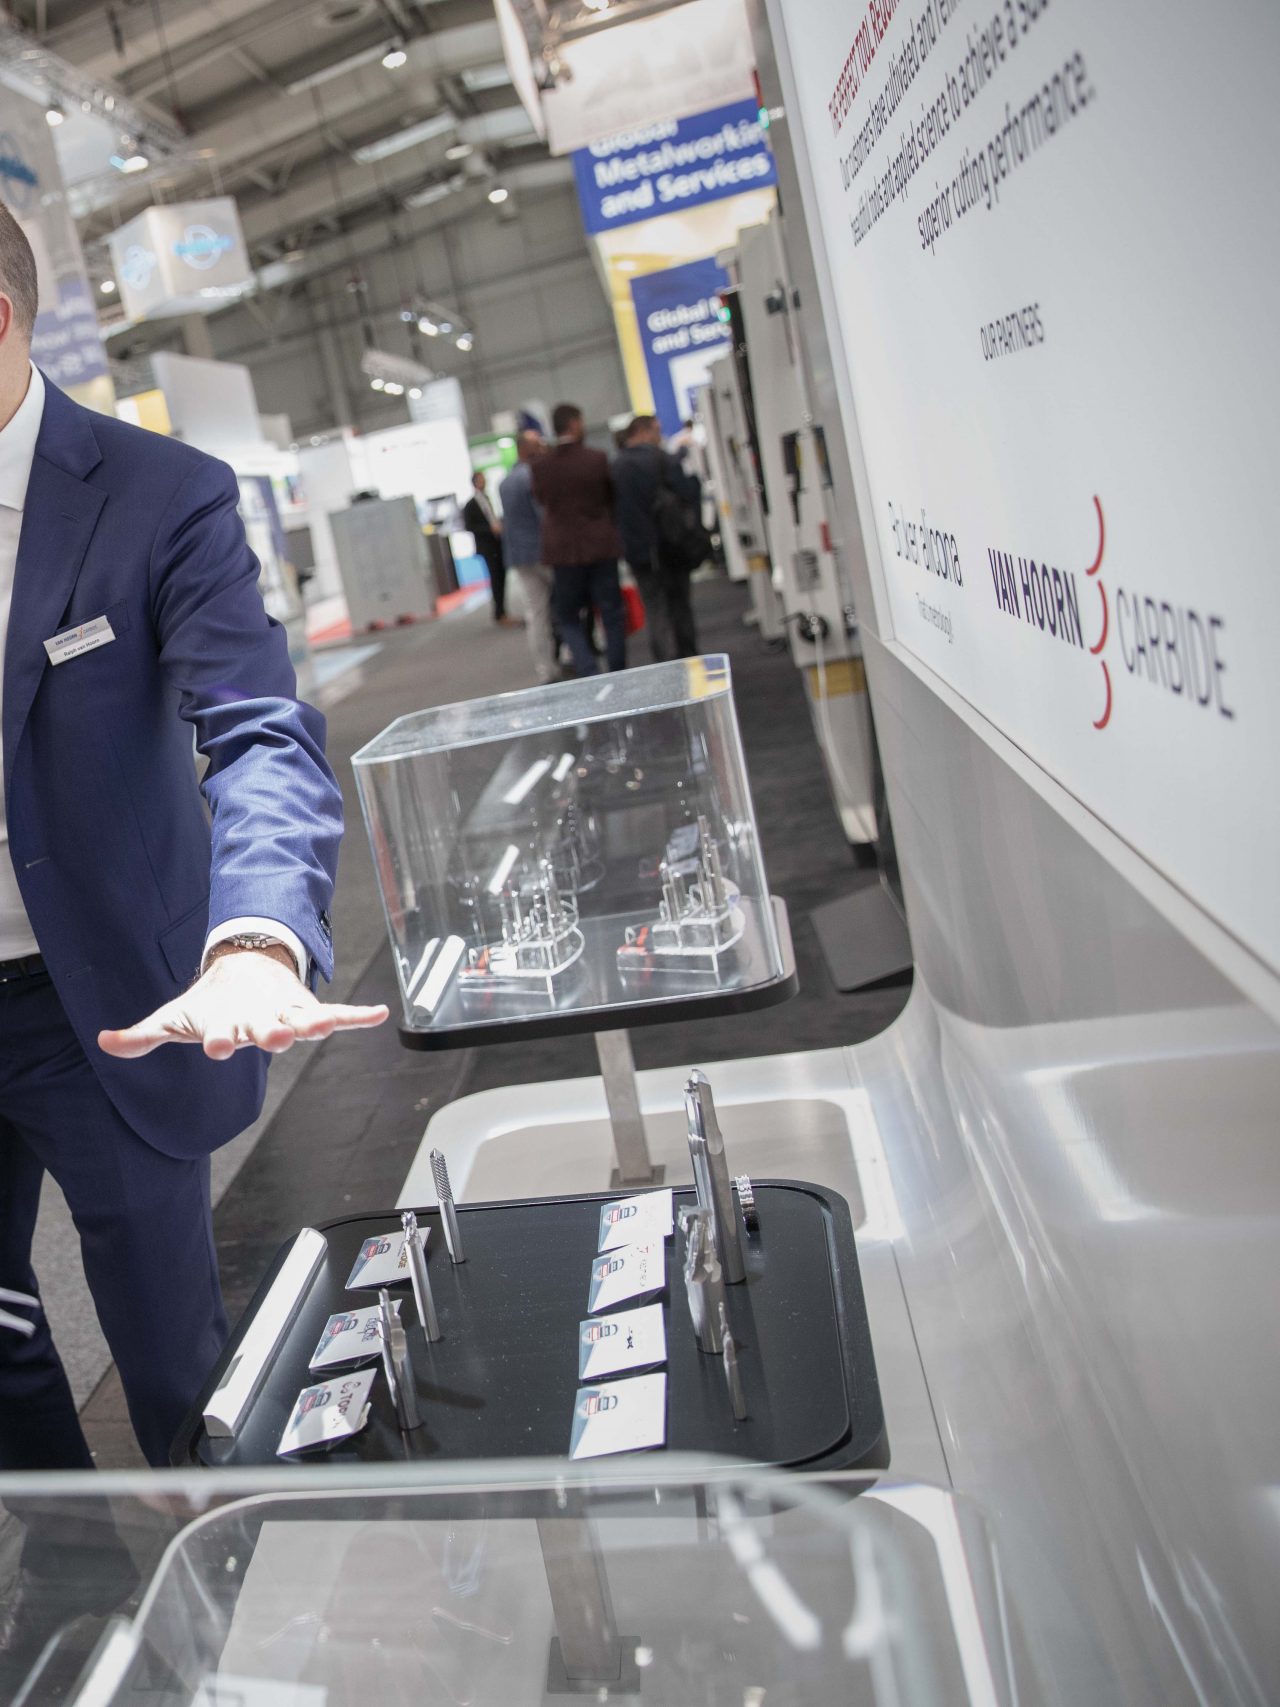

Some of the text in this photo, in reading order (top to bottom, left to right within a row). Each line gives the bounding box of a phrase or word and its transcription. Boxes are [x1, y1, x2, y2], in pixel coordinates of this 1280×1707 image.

[836, 43, 861, 122] PERFECT
[855, 14, 876, 78] TOOL
[848, 116, 875, 180] customers
[868, 92, 888, 142] have
[885, 18, 920, 118] cultivated
[917, 0, 937, 62] and
[867, 175, 885, 224] tools
[881, 154, 896, 209] and
[892, 119, 920, 203] applied
[916, 90, 950, 163] science
[945, 71, 961, 122] to
[958, 20, 1005, 108] achieve
[1003, 0, 1019, 49] a
[593, 118, 768, 189] Metalworkin
[600, 152, 771, 219] and Services
[917, 50, 1098, 256] superior cutting performance.
[652, 327, 690, 355] and
[980, 302, 1044, 361] OUR PARTNERS
[918, 508, 965, 588] alicona
[986, 547, 1235, 720] VAN HOORN CARBIDE
